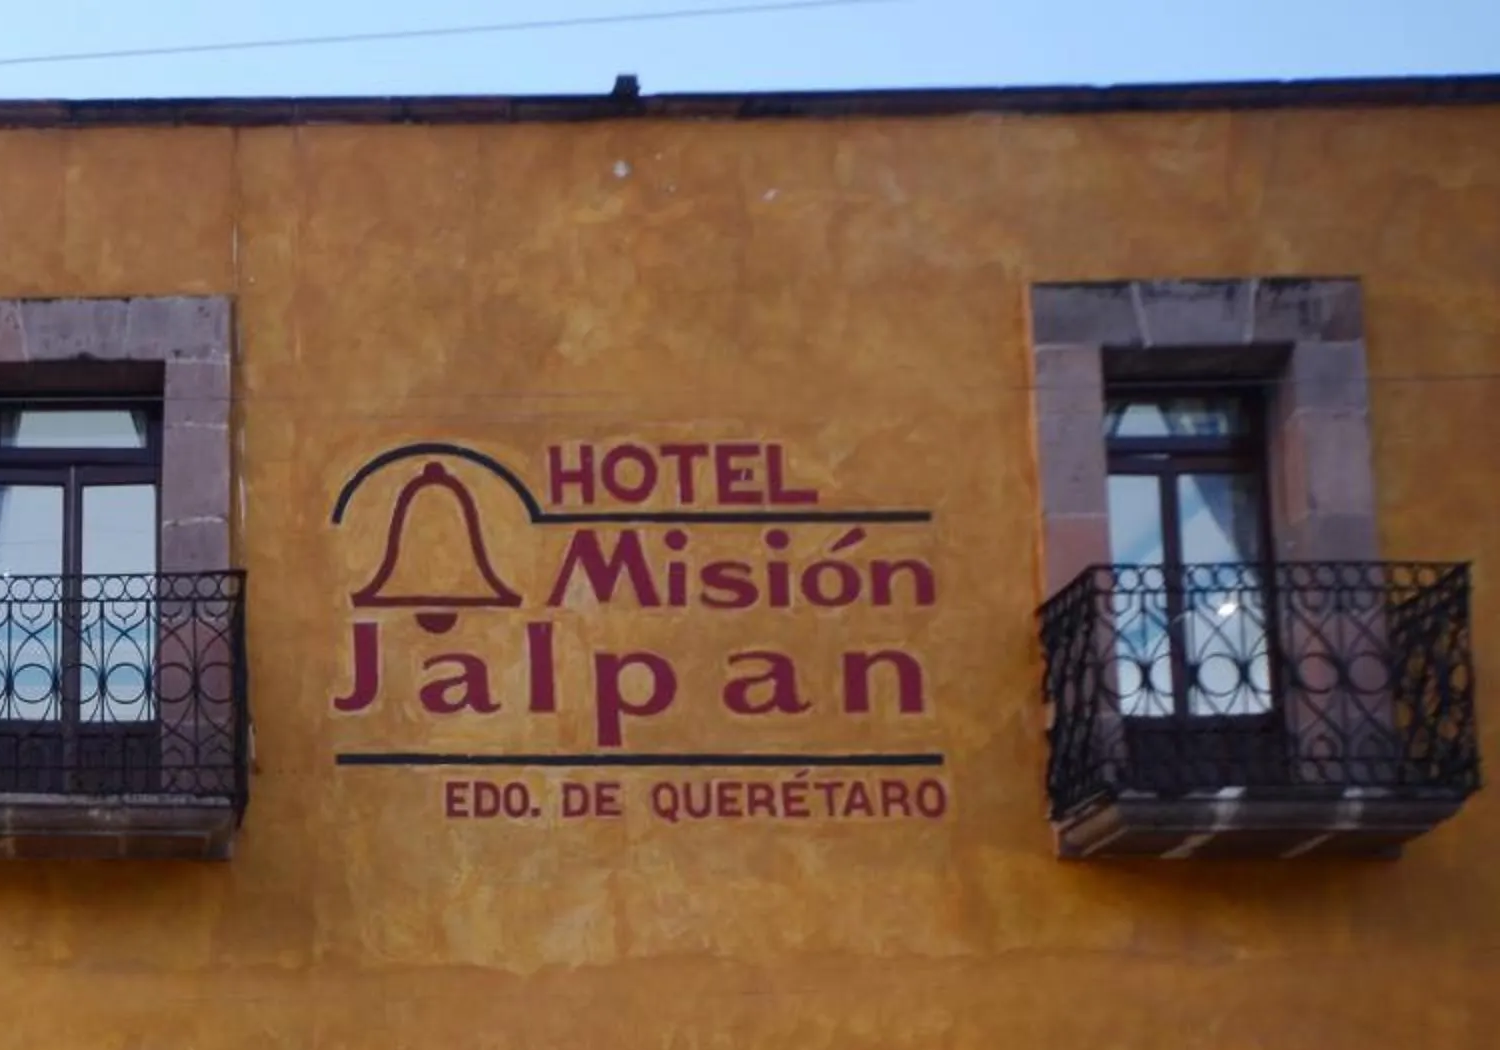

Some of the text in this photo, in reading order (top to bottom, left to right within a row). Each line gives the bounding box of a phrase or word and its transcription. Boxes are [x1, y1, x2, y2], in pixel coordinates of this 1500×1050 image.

[547, 443, 819, 506] HOTEL
[546, 527, 937, 610] Misión
[332, 621, 925, 747] Jalpan
[444, 768, 949, 823] EDO. DE QUERÉTARO
